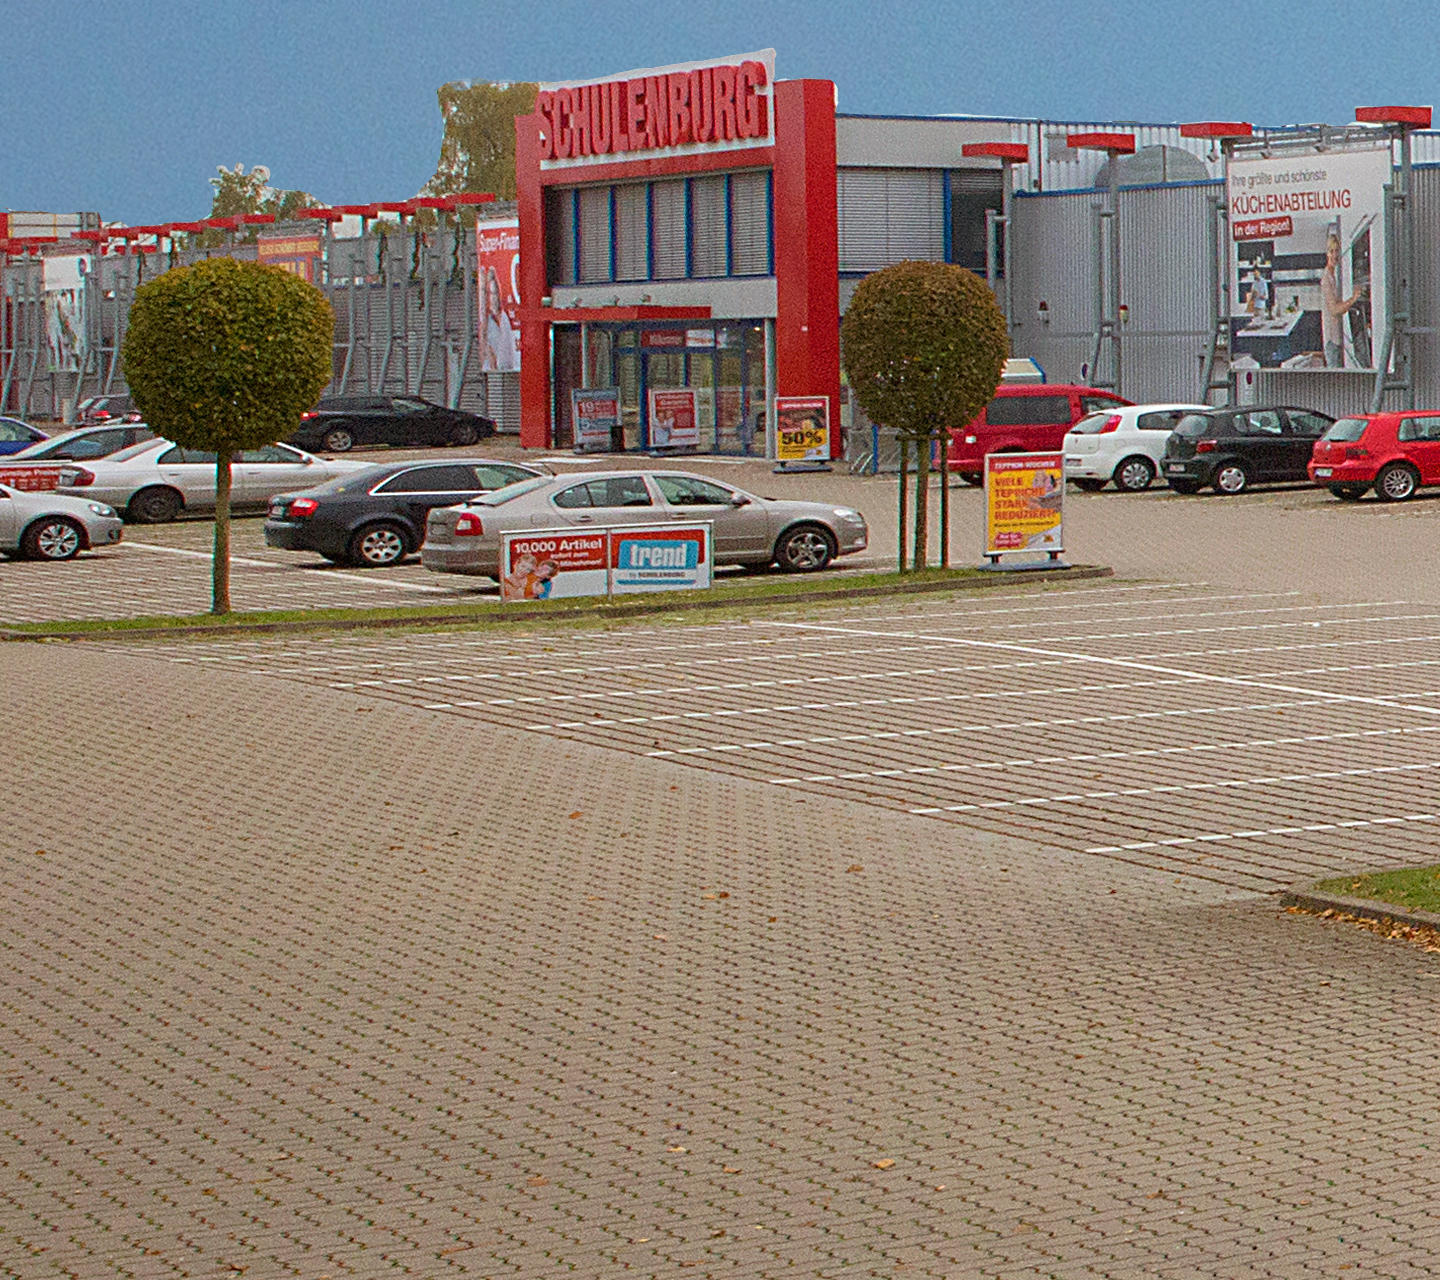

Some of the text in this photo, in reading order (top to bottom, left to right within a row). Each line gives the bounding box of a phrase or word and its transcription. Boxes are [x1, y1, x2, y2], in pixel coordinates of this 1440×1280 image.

[533, 60, 768, 160] SCHULENBURG
[1274, 172, 1289, 185] und
[1232, 188, 1351, 214] KÜCHENABTEILUNG
[1245, 222, 1258, 235] der
[782, 431, 823, 445] 50%
[560, 538, 603, 551] Artikel
[630, 543, 688, 568] trend
